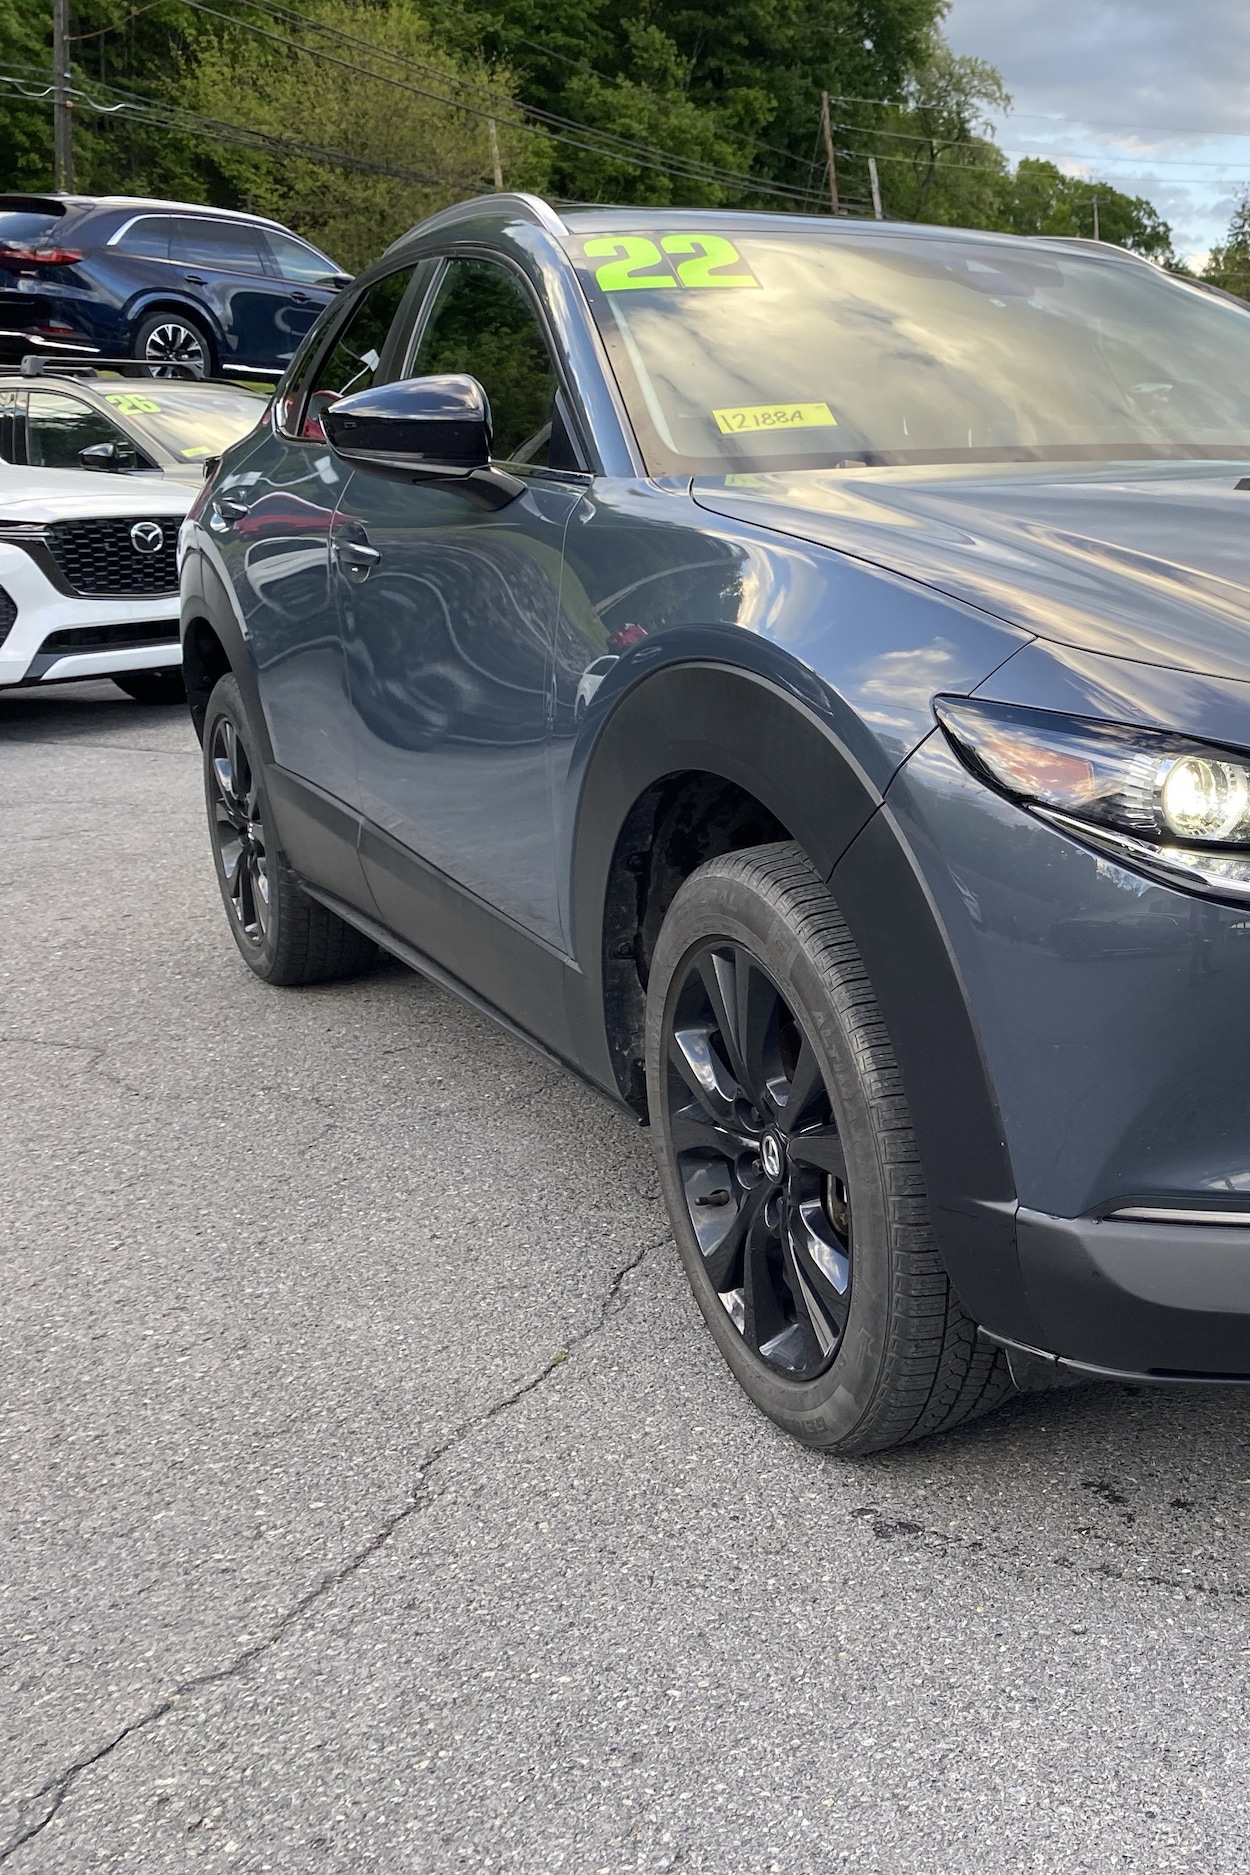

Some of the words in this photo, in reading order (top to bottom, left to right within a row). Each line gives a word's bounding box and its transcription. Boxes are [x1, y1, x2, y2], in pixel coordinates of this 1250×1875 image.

[583, 234, 764, 292] 22
[105, 393, 162, 416] 26
[720, 410, 804, 432] 12188A
